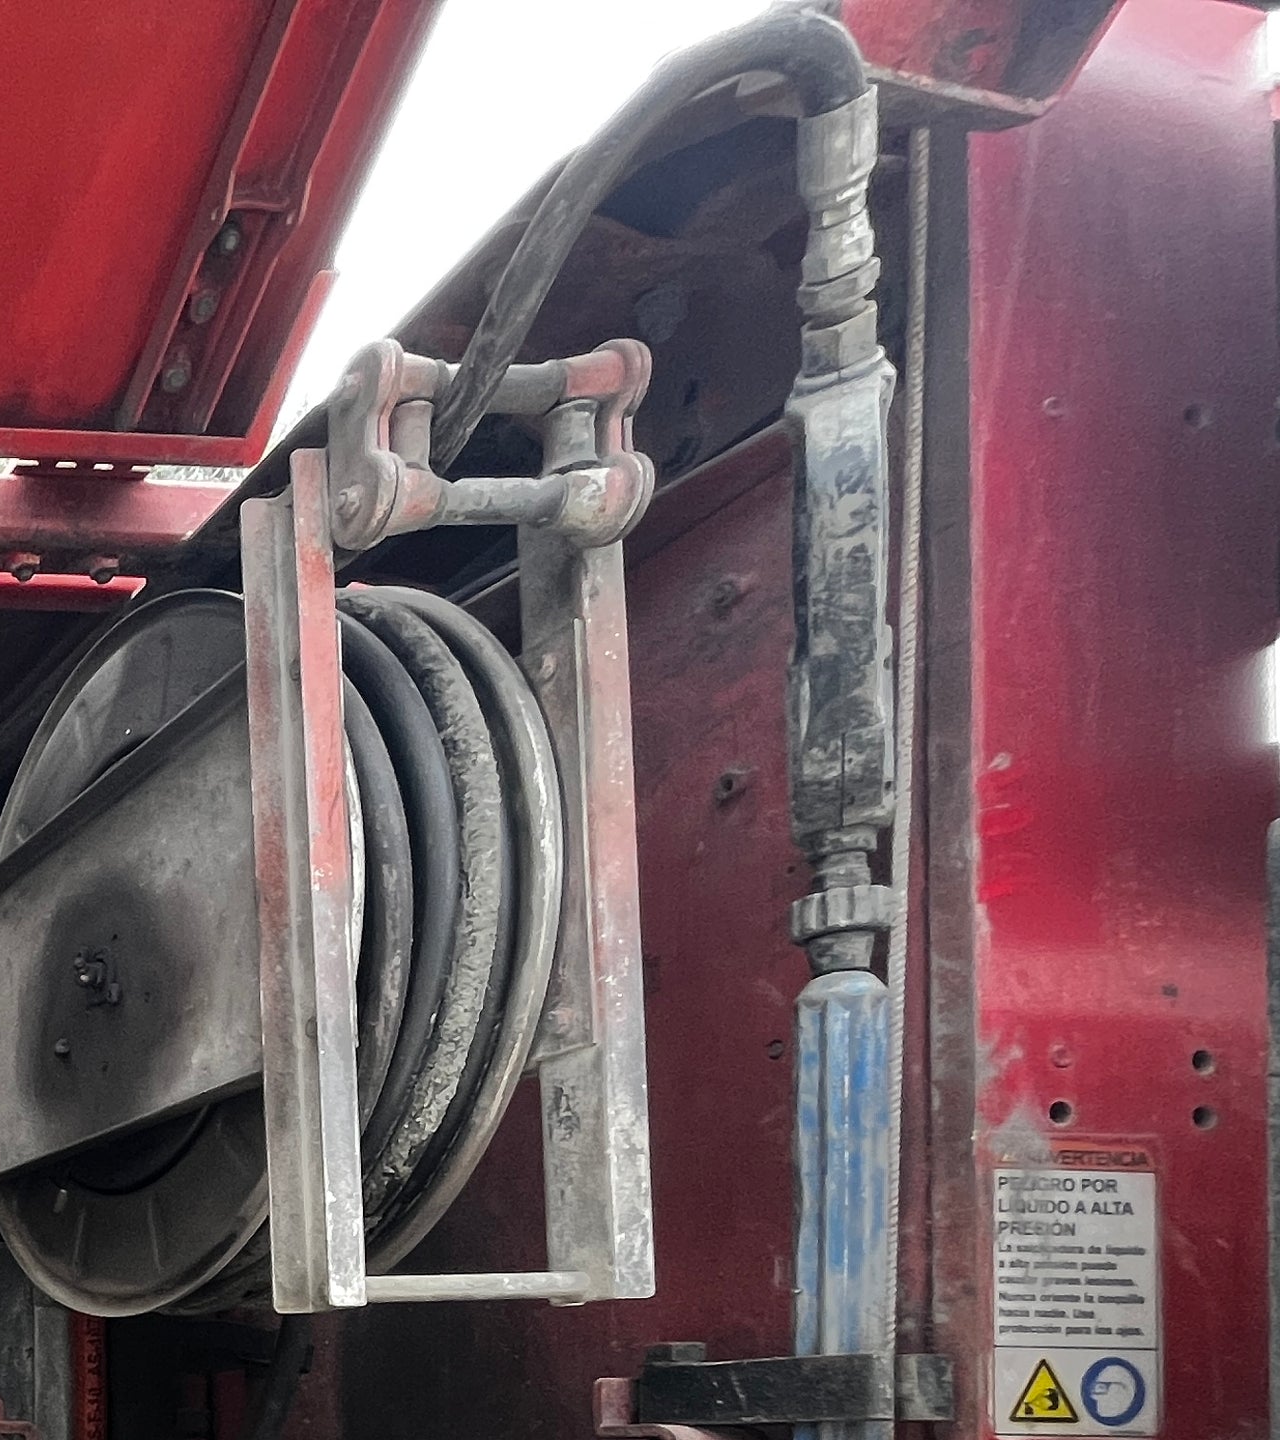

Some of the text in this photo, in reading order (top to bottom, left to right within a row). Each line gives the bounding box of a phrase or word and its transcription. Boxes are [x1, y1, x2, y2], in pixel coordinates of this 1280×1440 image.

[1029, 1151, 1149, 1165] DVERTENCIA
[998, 1176, 1118, 1193] PELIGRO POR
[1075, 1200, 1087, 1214] A
[1090, 1201, 1134, 1215] ALTA
